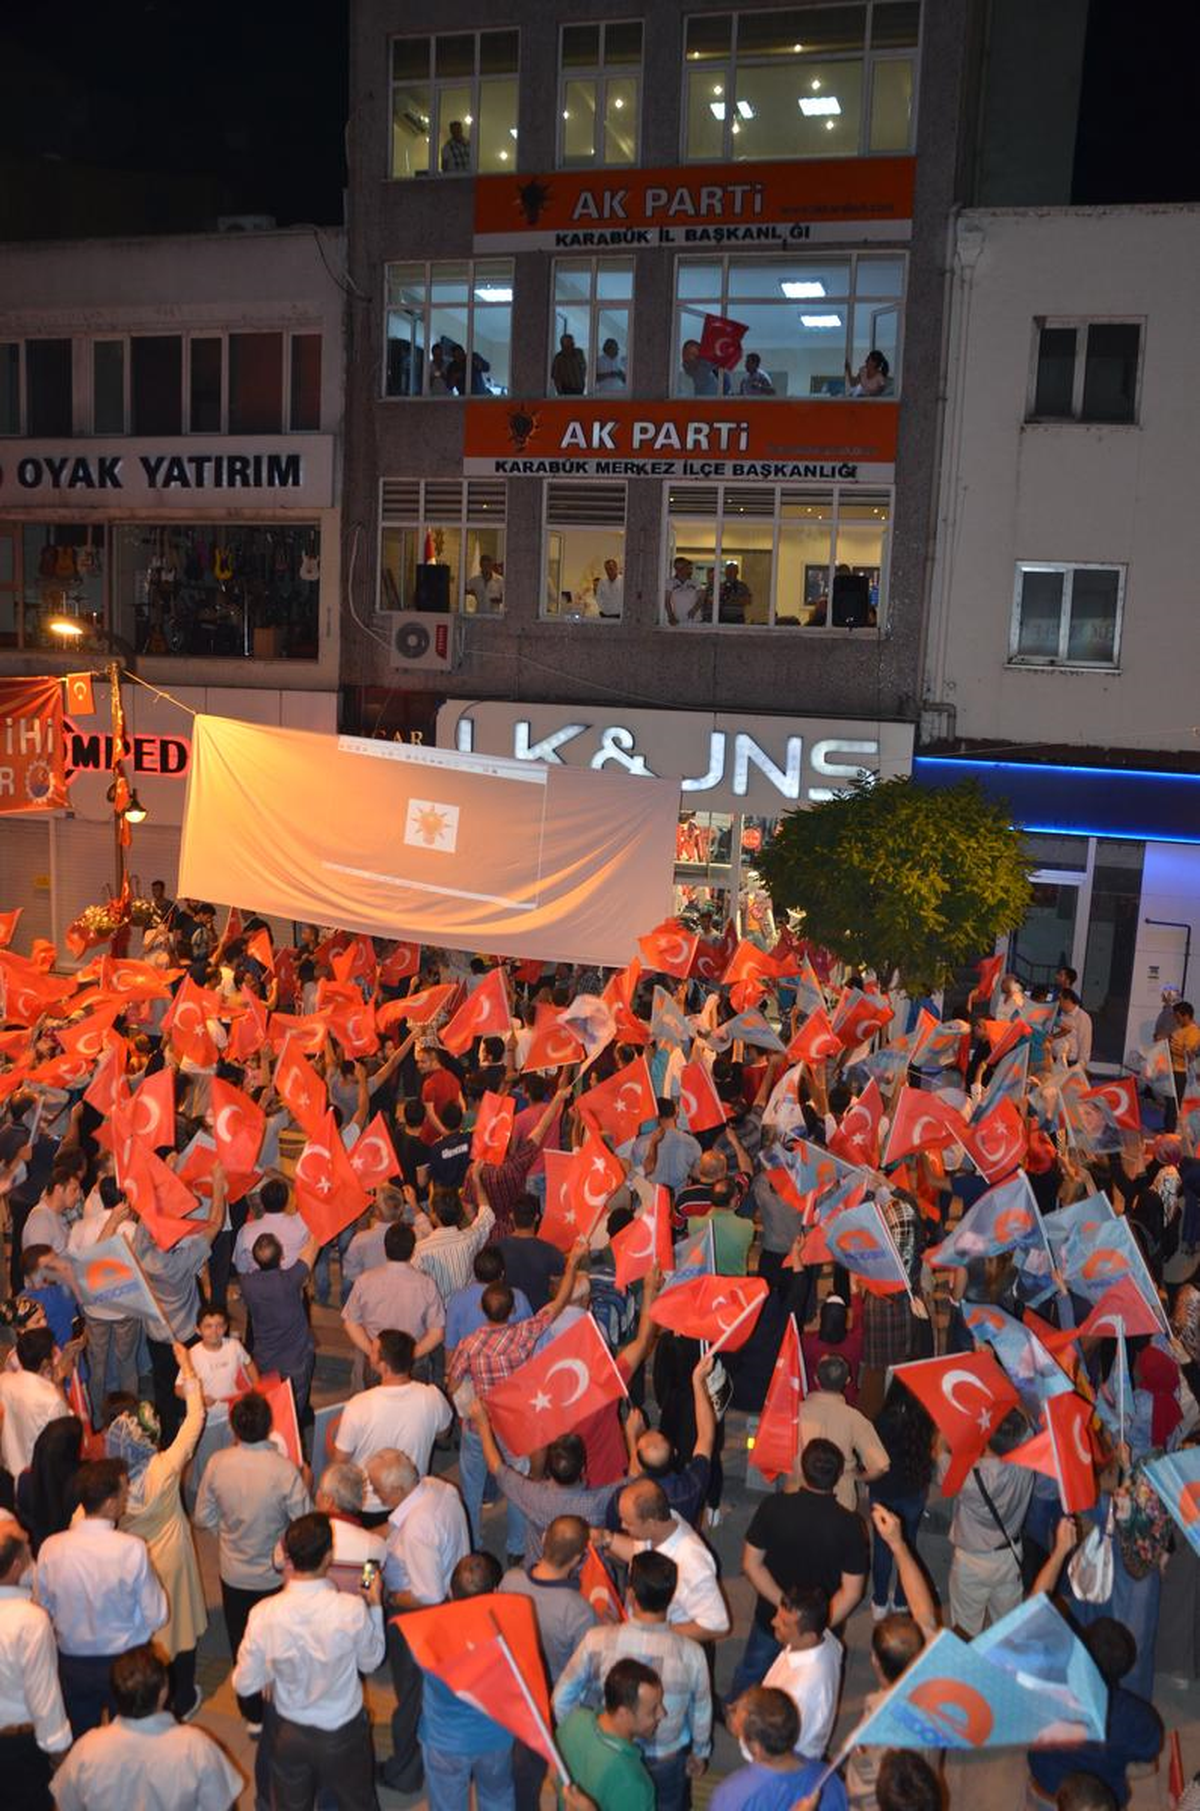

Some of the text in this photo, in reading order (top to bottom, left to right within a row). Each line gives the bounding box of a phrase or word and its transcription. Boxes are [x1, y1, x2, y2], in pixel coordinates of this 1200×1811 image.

[571, 189, 630, 220] AK
[555, 226, 650, 247] KARABÜK
[659, 225, 676, 243] İL
[560, 421, 620, 450] AK
[17, 454, 301, 489] OYAK YATIRIM
[494, 458, 858, 479] KARABÜK MERKEZ İLÇE BAŞKANLIĞI
[681, 730, 880, 802] JNS
